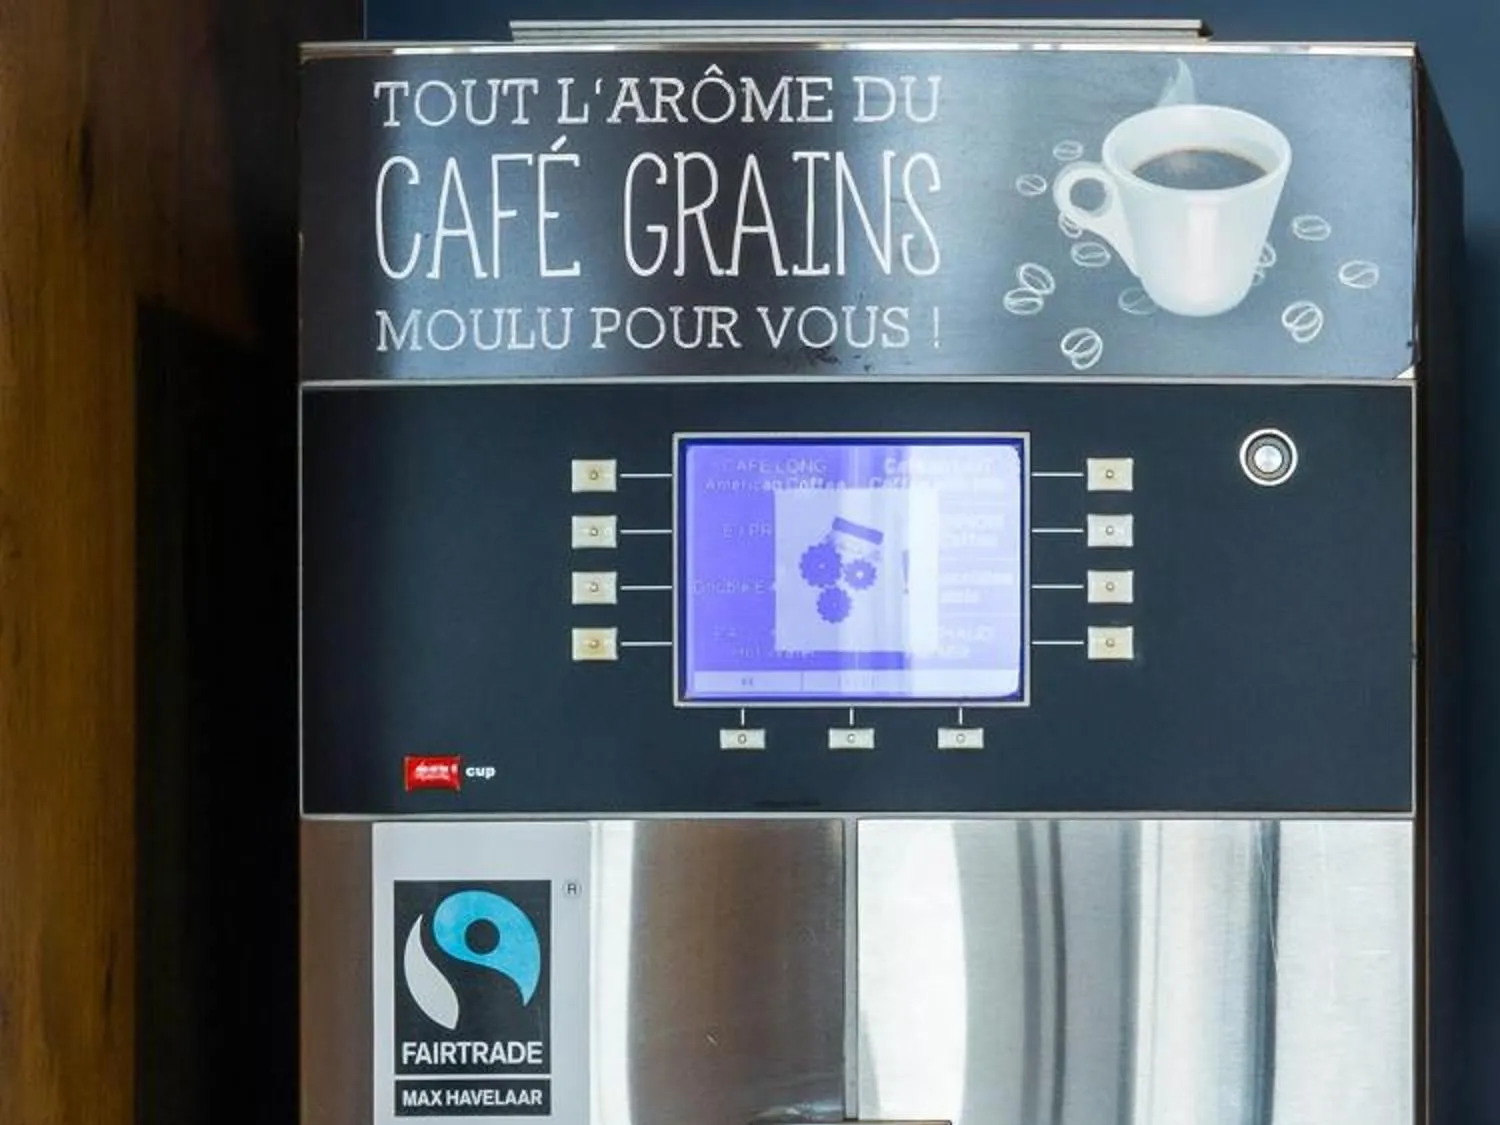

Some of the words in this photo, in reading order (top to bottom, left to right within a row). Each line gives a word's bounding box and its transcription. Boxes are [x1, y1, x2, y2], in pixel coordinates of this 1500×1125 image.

[374, 80, 538, 127] TOUT
[853, 76, 942, 122] DU
[375, 135, 582, 280] CAFÉ
[623, 151, 942, 277] GRAINS
[375, 308, 572, 352] MOULU
[589, 306, 742, 350] POUR
[756, 305, 911, 350] VOUS
[465, 766, 496, 780] cup
[401, 1041, 543, 1066] FAIRTRADE
[402, 1090, 444, 1107] MAX
[446, 1089, 543, 1106] HAVELAAR
